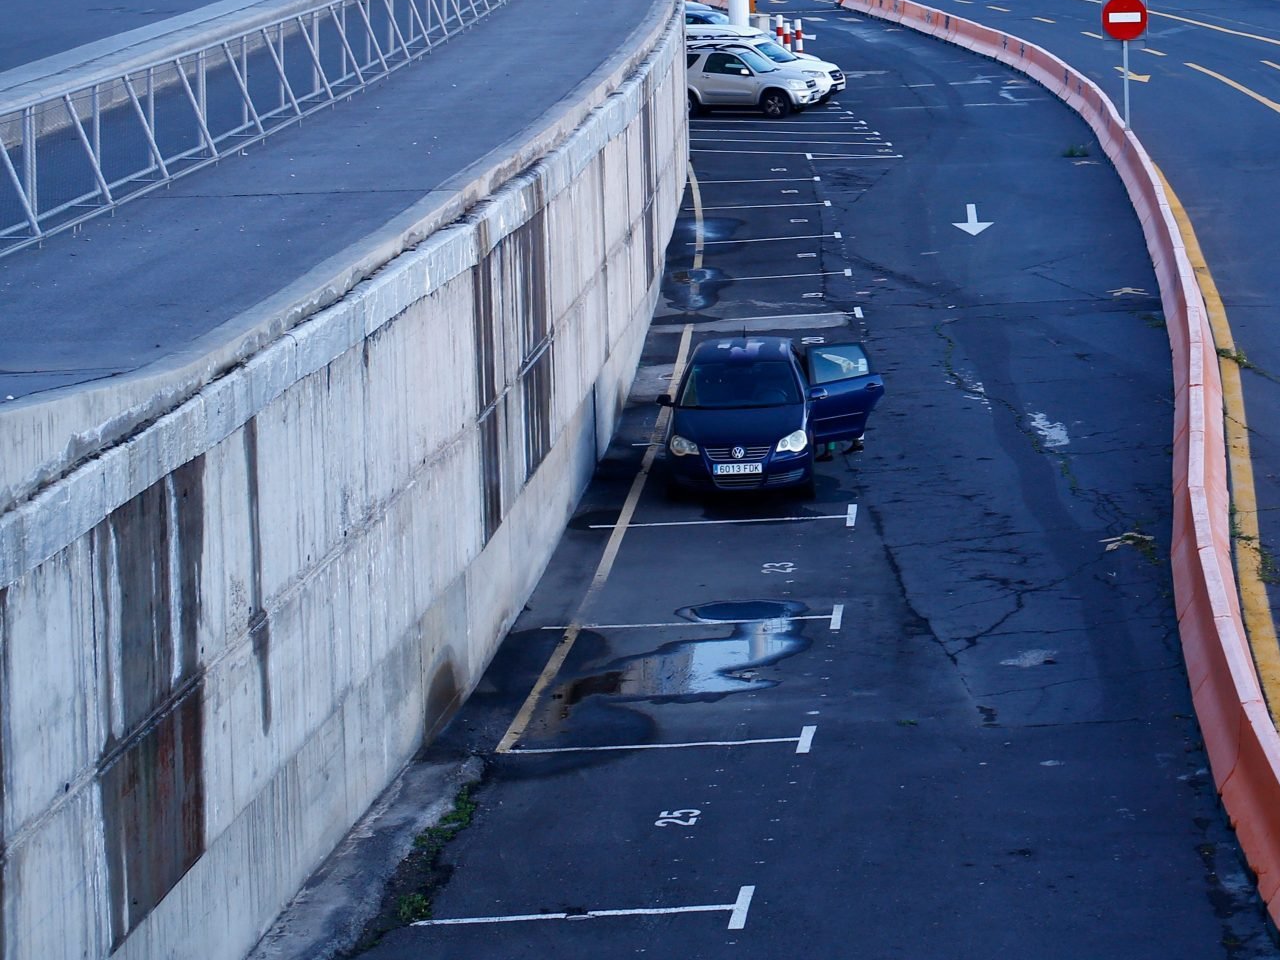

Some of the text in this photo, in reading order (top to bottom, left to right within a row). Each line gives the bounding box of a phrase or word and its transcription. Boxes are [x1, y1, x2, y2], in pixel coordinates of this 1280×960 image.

[720, 463, 760, 474] 6013 FDK
[761, 561, 798, 574] 23
[654, 808, 702, 828] 25
